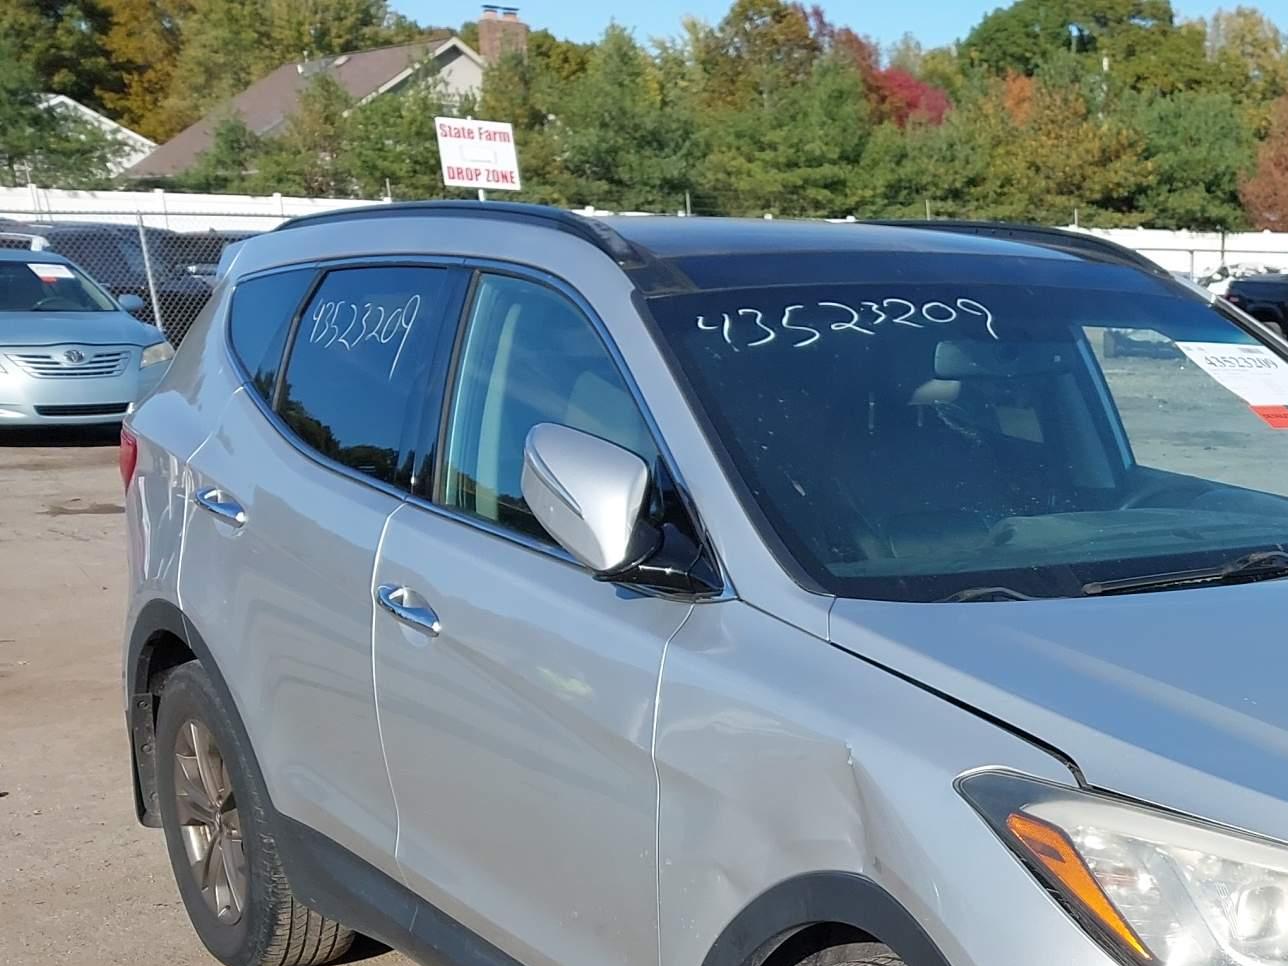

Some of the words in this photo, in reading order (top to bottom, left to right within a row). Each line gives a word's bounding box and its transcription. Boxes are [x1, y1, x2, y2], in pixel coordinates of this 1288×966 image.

[439, 123, 475, 140] State
[477, 127, 511, 143] Farm
[446, 166, 482, 181] DROP
[485, 168, 516, 184] ZONE
[696, 298, 999, 352] 43523209
[309, 294, 421, 382] 43523209
[1204, 355, 1279, 369] 43523209
